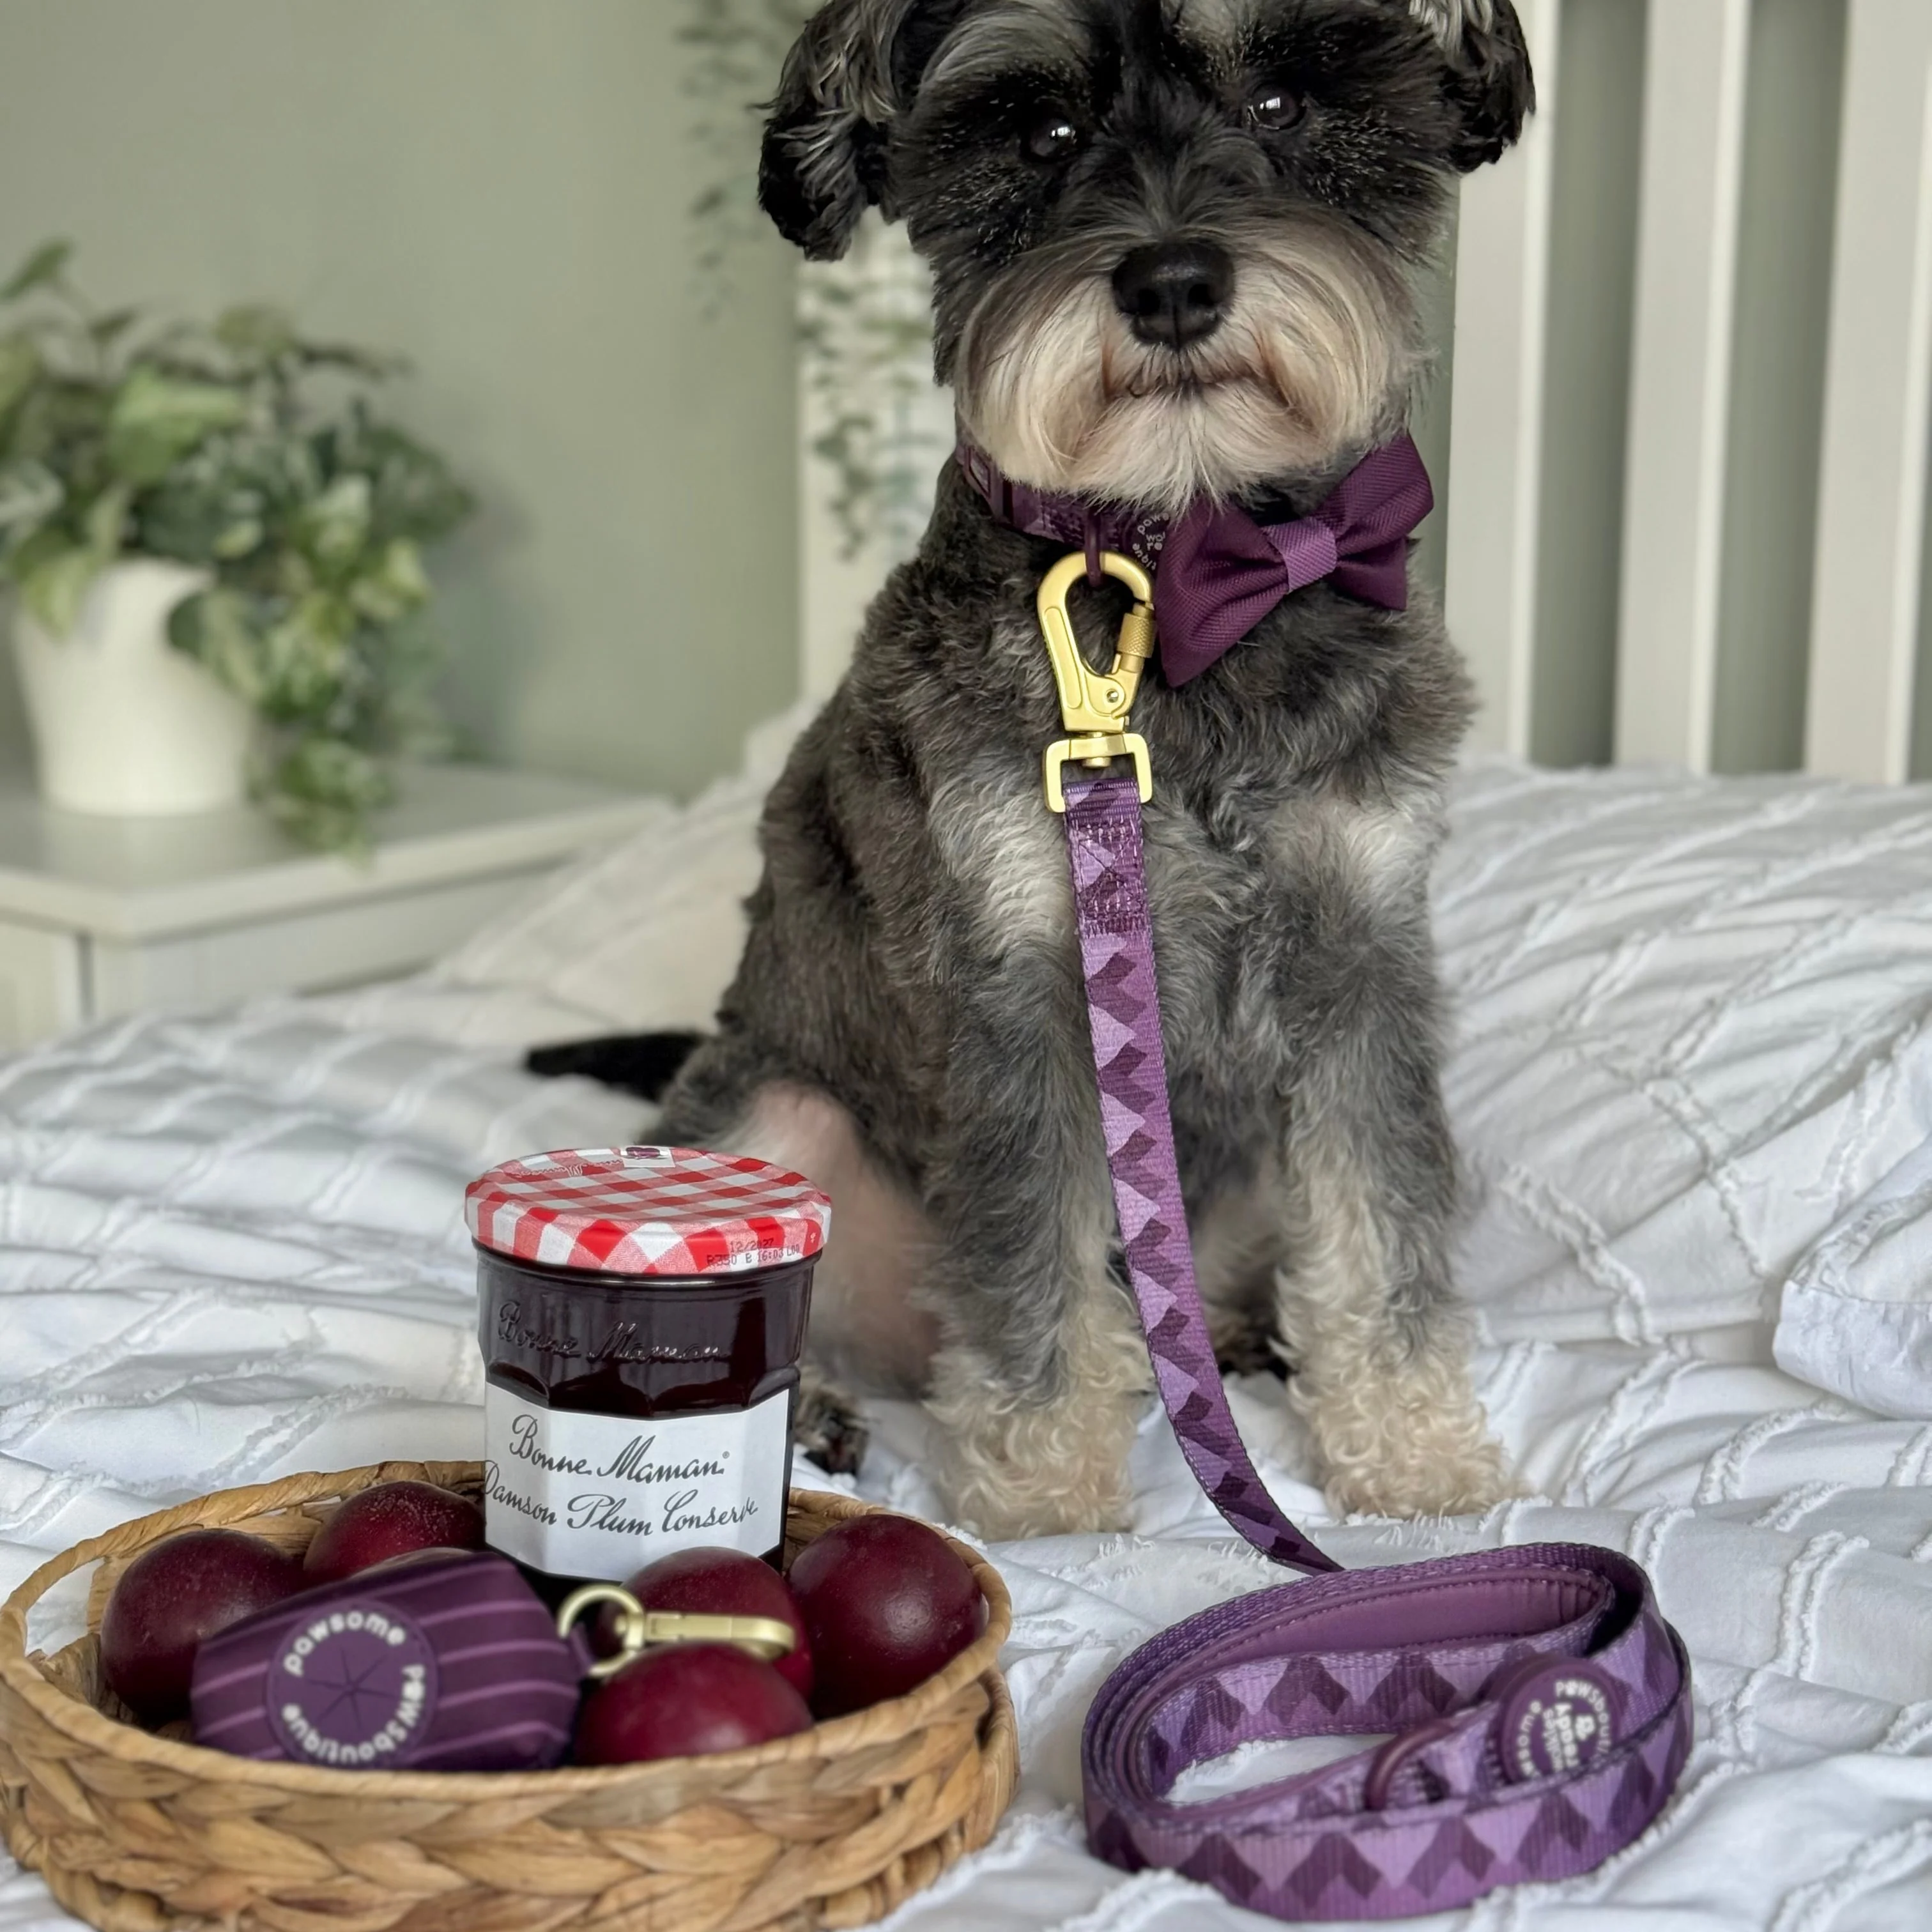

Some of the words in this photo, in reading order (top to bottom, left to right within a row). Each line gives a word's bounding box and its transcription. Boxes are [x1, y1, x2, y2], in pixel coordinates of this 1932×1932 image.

[758, 1248, 784, 1262] 16:03
[509, 1414, 592, 1469] Bonne
[483, 1459, 557, 1525] Damson
[567, 1493, 653, 1537] Plum
[283, 1610, 406, 1677] pawsome
